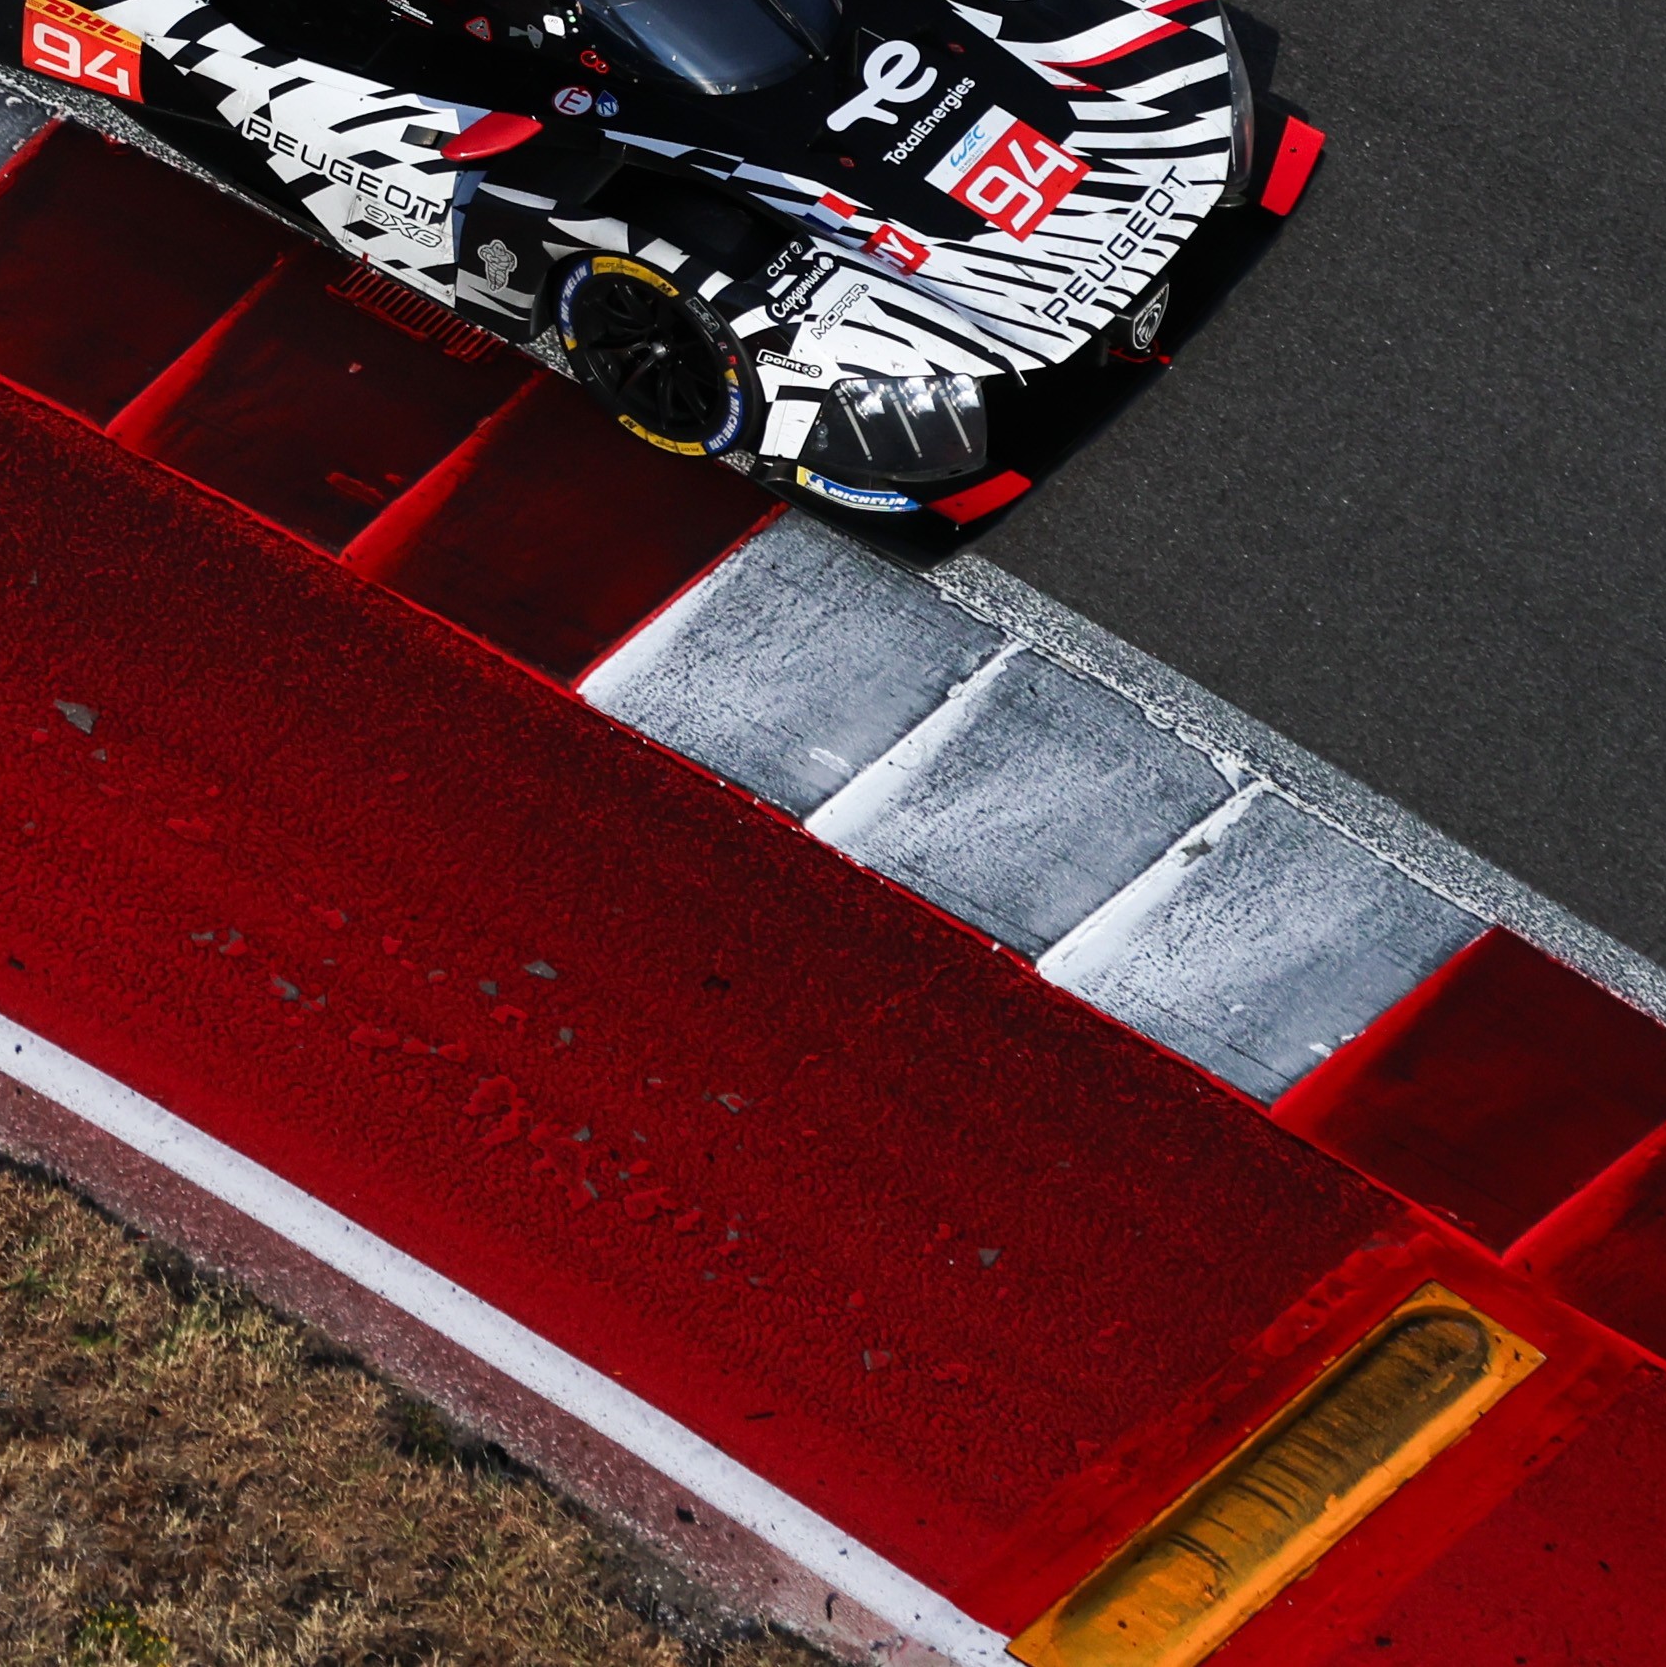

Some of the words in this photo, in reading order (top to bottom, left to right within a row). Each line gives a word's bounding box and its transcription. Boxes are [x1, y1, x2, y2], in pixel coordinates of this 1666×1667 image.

[33, 22, 131, 96] 94
[882, 77, 976, 166] TotalEnergies
[950, 124, 986, 168] WEC
[244, 117, 443, 221] PEUGEOT
[965, 138, 1079, 233] 94
[364, 204, 443, 248] 9X8
[1041, 165, 1188, 326] PEUGEOT
[767, 250, 793, 277] CUT
[771, 265, 827, 318] Capgemini
[709, 396, 740, 451] MICHELIN
[828, 487, 909, 506] MICHELIN
